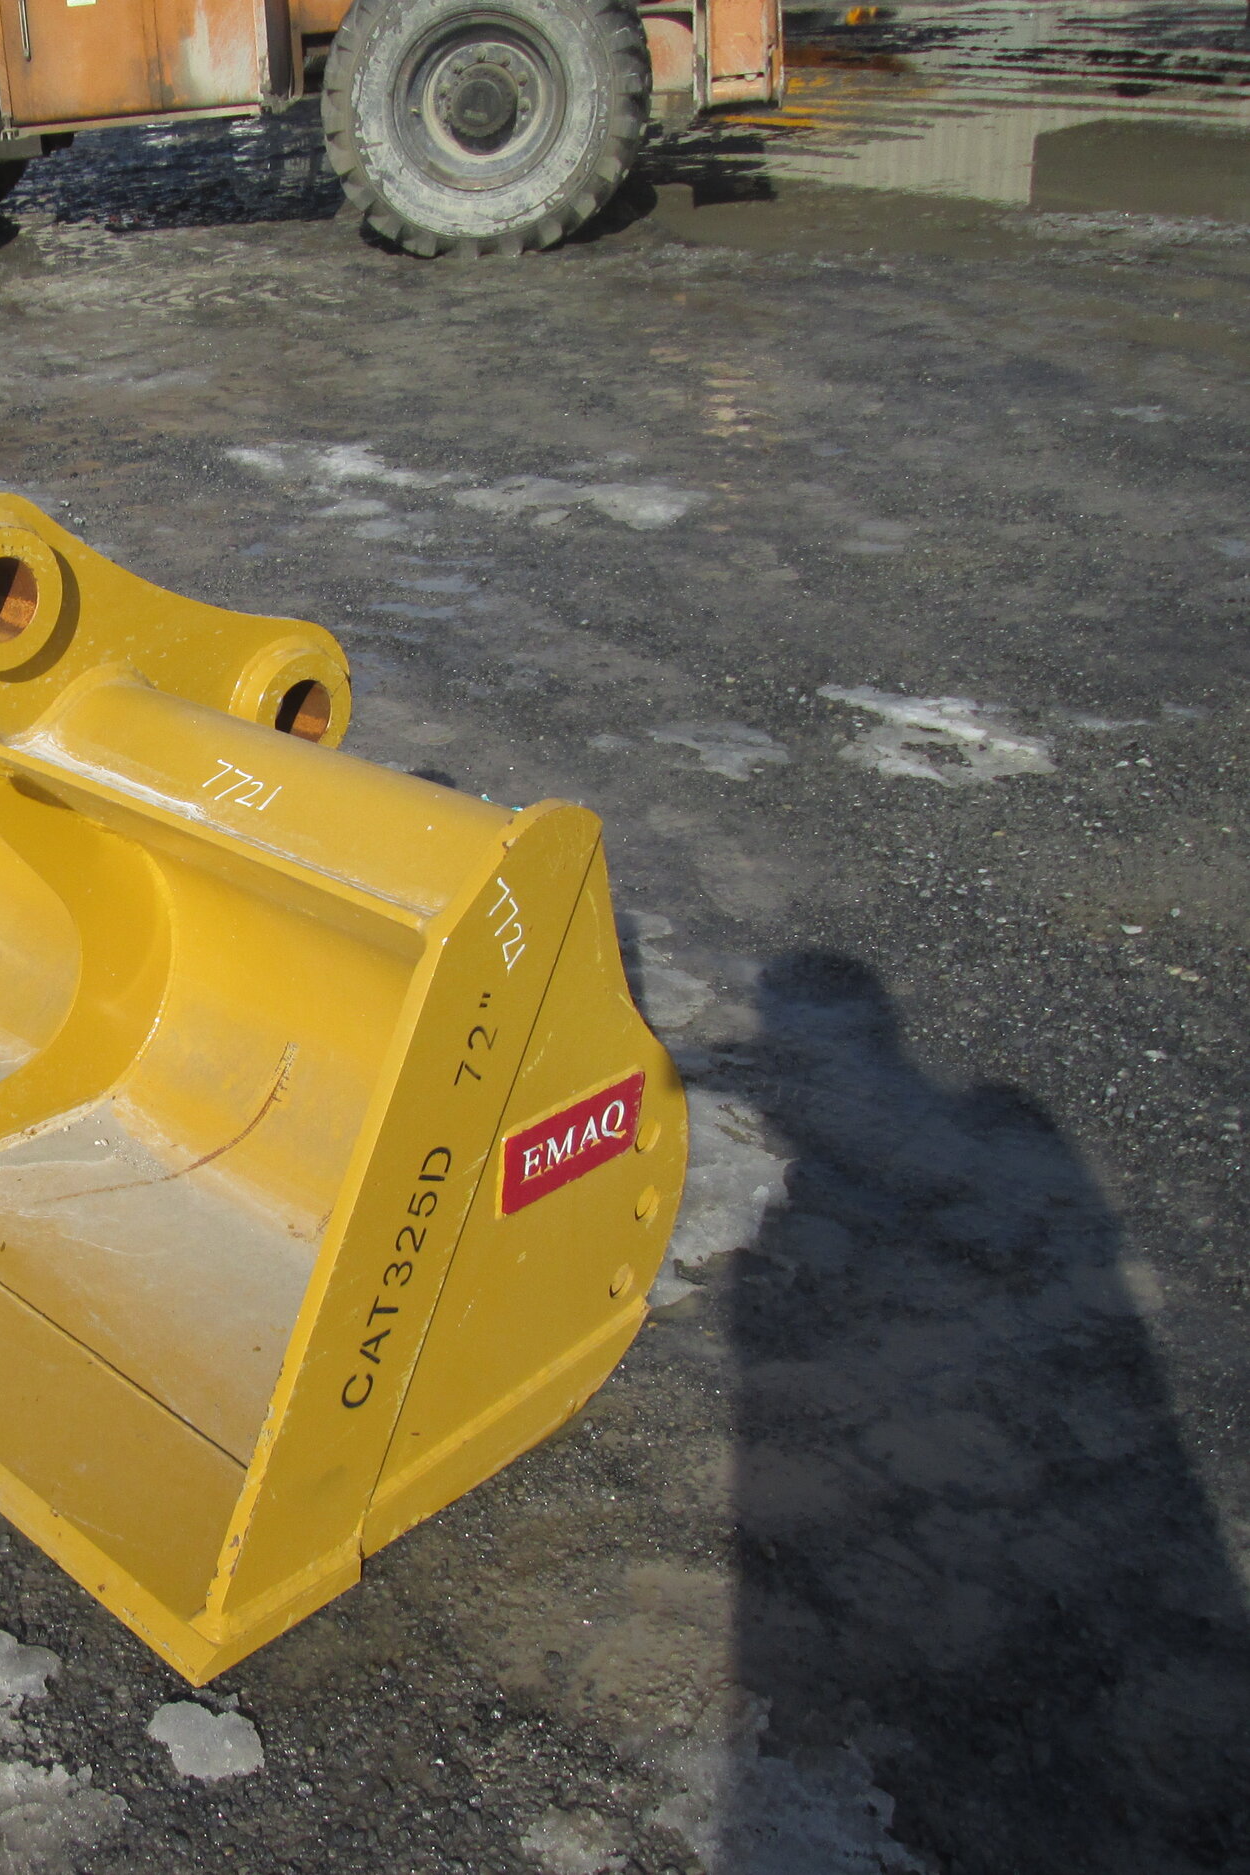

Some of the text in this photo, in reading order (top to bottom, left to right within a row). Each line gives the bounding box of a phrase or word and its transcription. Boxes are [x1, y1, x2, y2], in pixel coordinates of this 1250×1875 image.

[202, 758, 283, 811] 7721
[487, 876, 526, 971] 7721
[453, 991, 499, 1089] 72"
[519, 1098, 628, 1184] EMAQ
[340, 1145, 452, 1410] CAT325D
